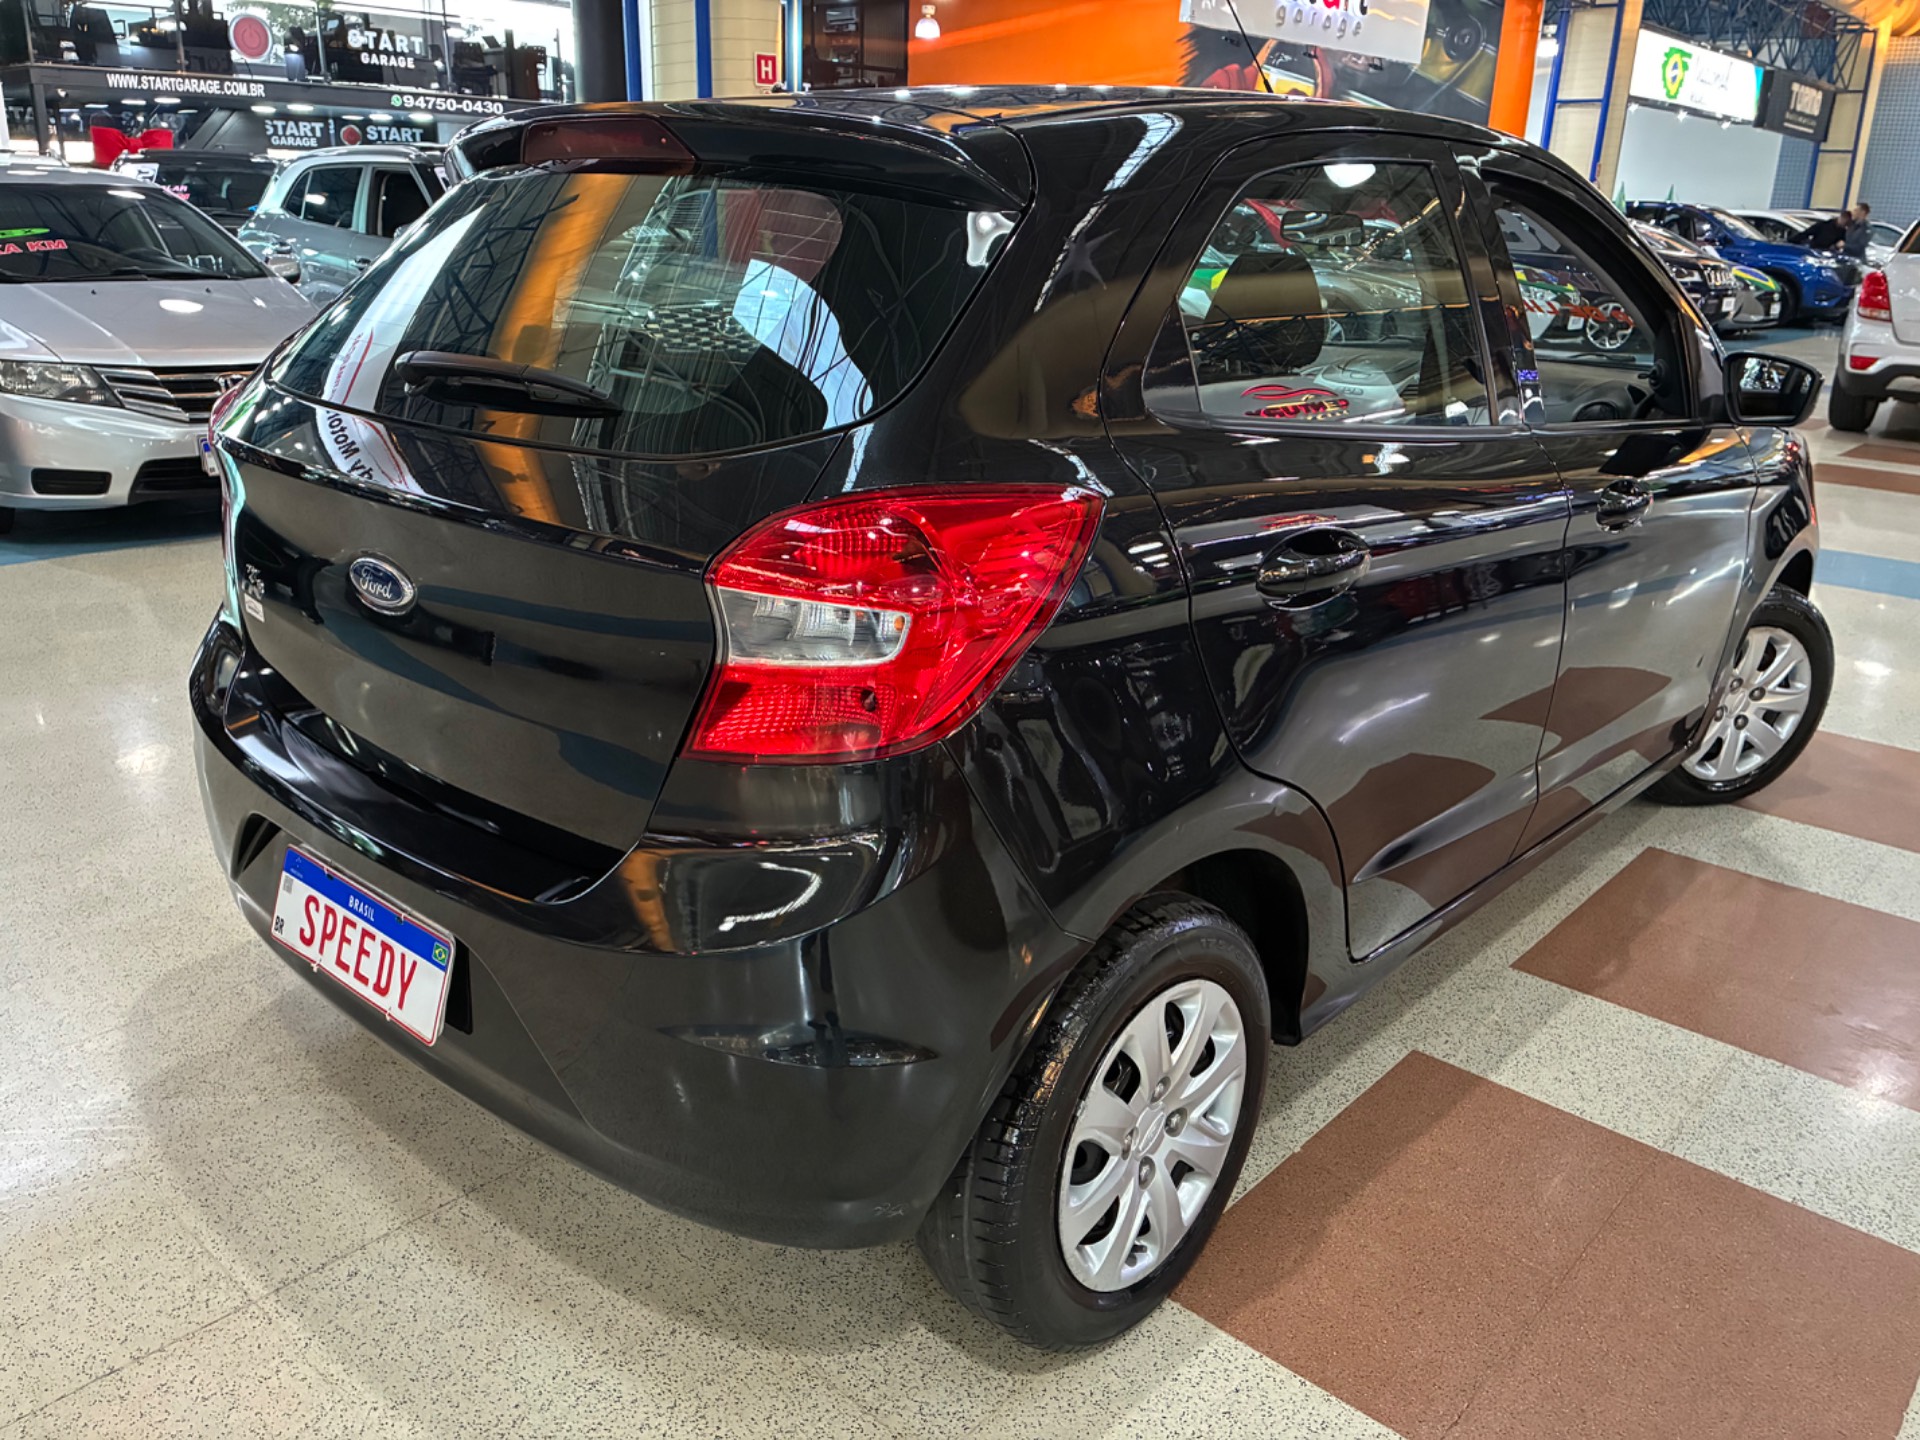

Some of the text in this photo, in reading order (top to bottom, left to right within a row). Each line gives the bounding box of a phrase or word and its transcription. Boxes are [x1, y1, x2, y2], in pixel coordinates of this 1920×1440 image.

[1274, 5, 1362, 39] garage
[347, 29, 423, 55] START
[360, 51, 415, 69] GARAGE
[760, 59, 773, 80] H
[106, 73, 266, 97] WWW.STARTGARAGE.COM.BR
[402, 95, 504, 115] 94750-0430
[264, 119, 324, 137] START
[366, 125, 424, 143] START
[270, 135, 318, 147] GARAGE
[26, 239, 68, 252] KM
[359, 565, 393, 599] Ford
[348, 894, 375, 922] BRASIL
[274, 915, 285, 935] BR
[299, 894, 418, 1011] SPEEDY
